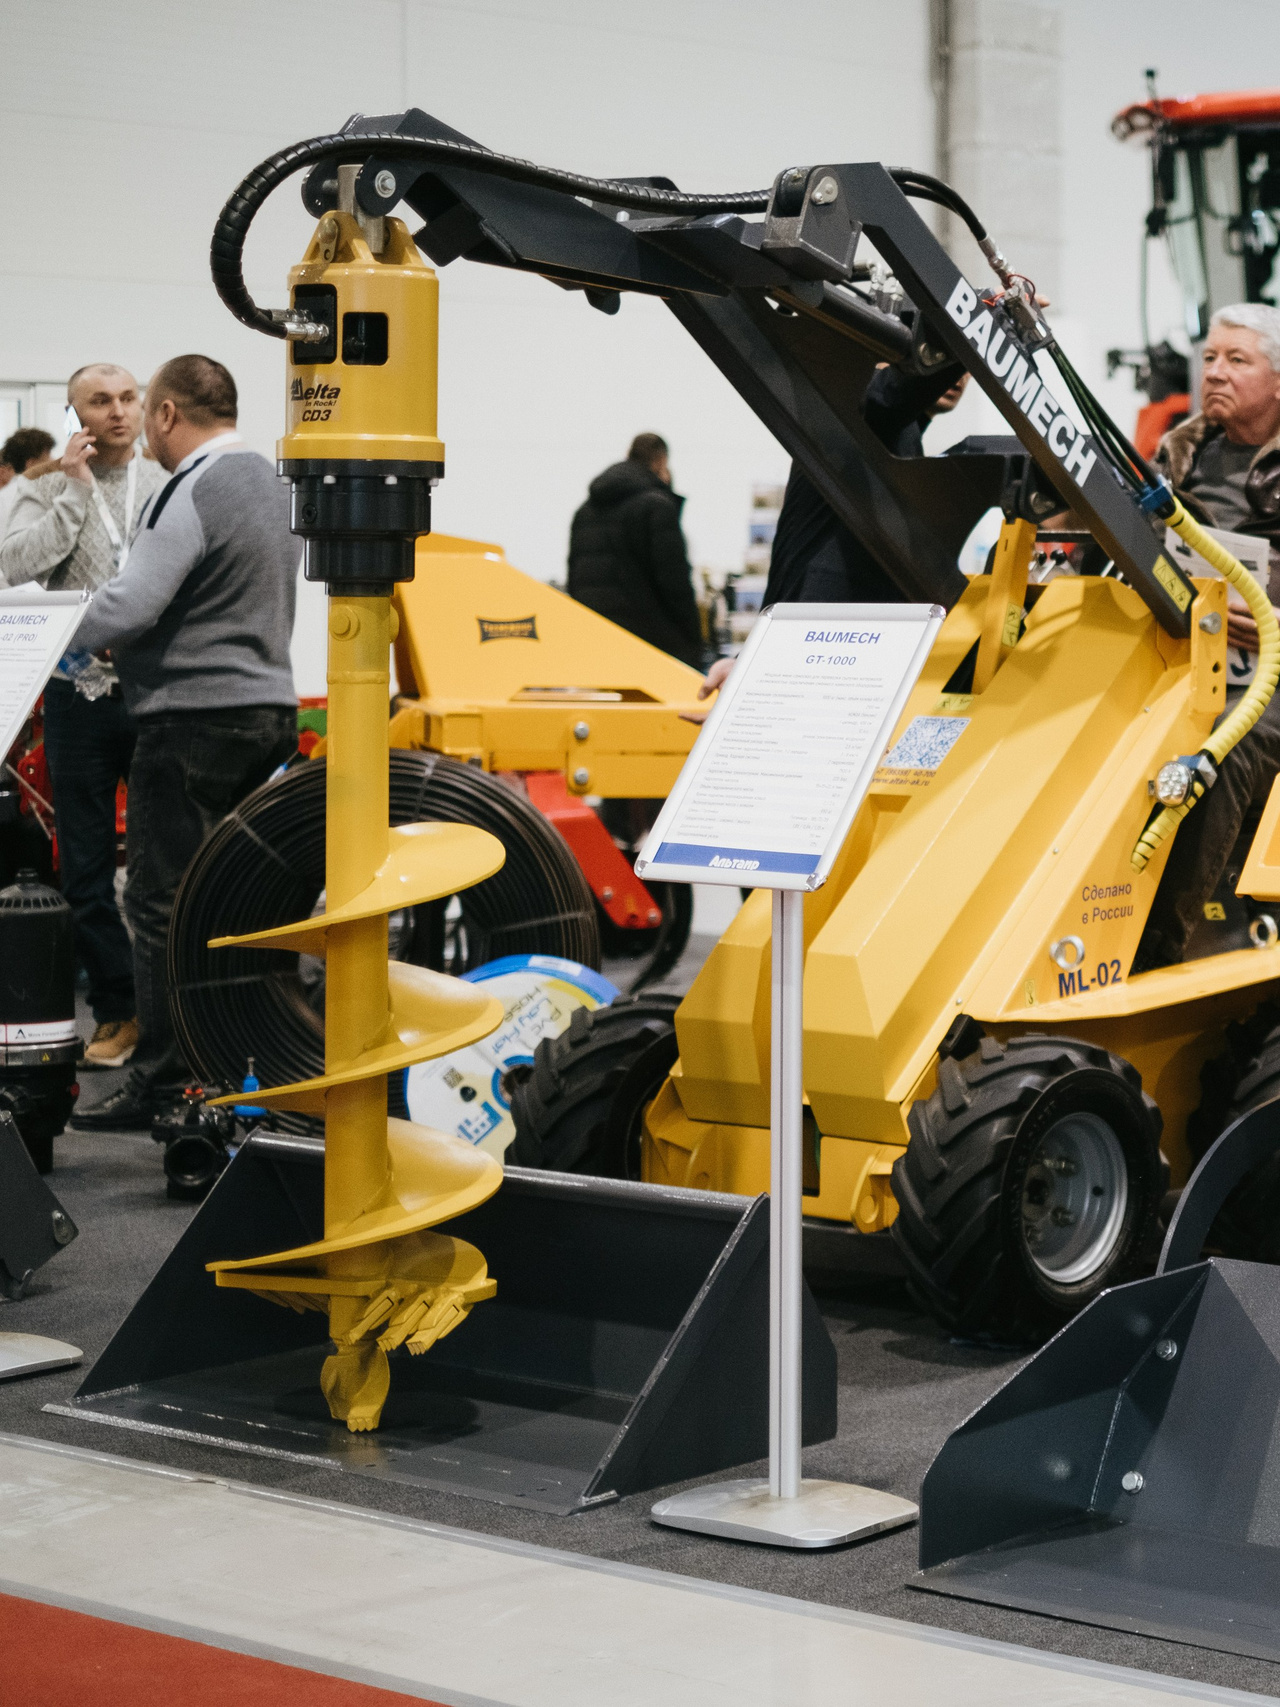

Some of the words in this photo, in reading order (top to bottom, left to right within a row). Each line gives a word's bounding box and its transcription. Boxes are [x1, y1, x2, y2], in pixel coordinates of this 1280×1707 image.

[945, 277, 1098, 488] BAUMECH
[302, 409, 332, 422] CD3
[0, 615, 49, 625] BAUMECH
[804, 631, 881, 644] BAUMECH
[805, 655, 857, 666] GT-1000
[708, 855, 760, 871] Альтаир
[1082, 883, 1132, 902] Сделано
[1082, 913, 1089, 925] в
[1092, 905, 1134, 923] России
[1058, 959, 1123, 998] ML-02
[504, 986, 541, 1022] Hose
